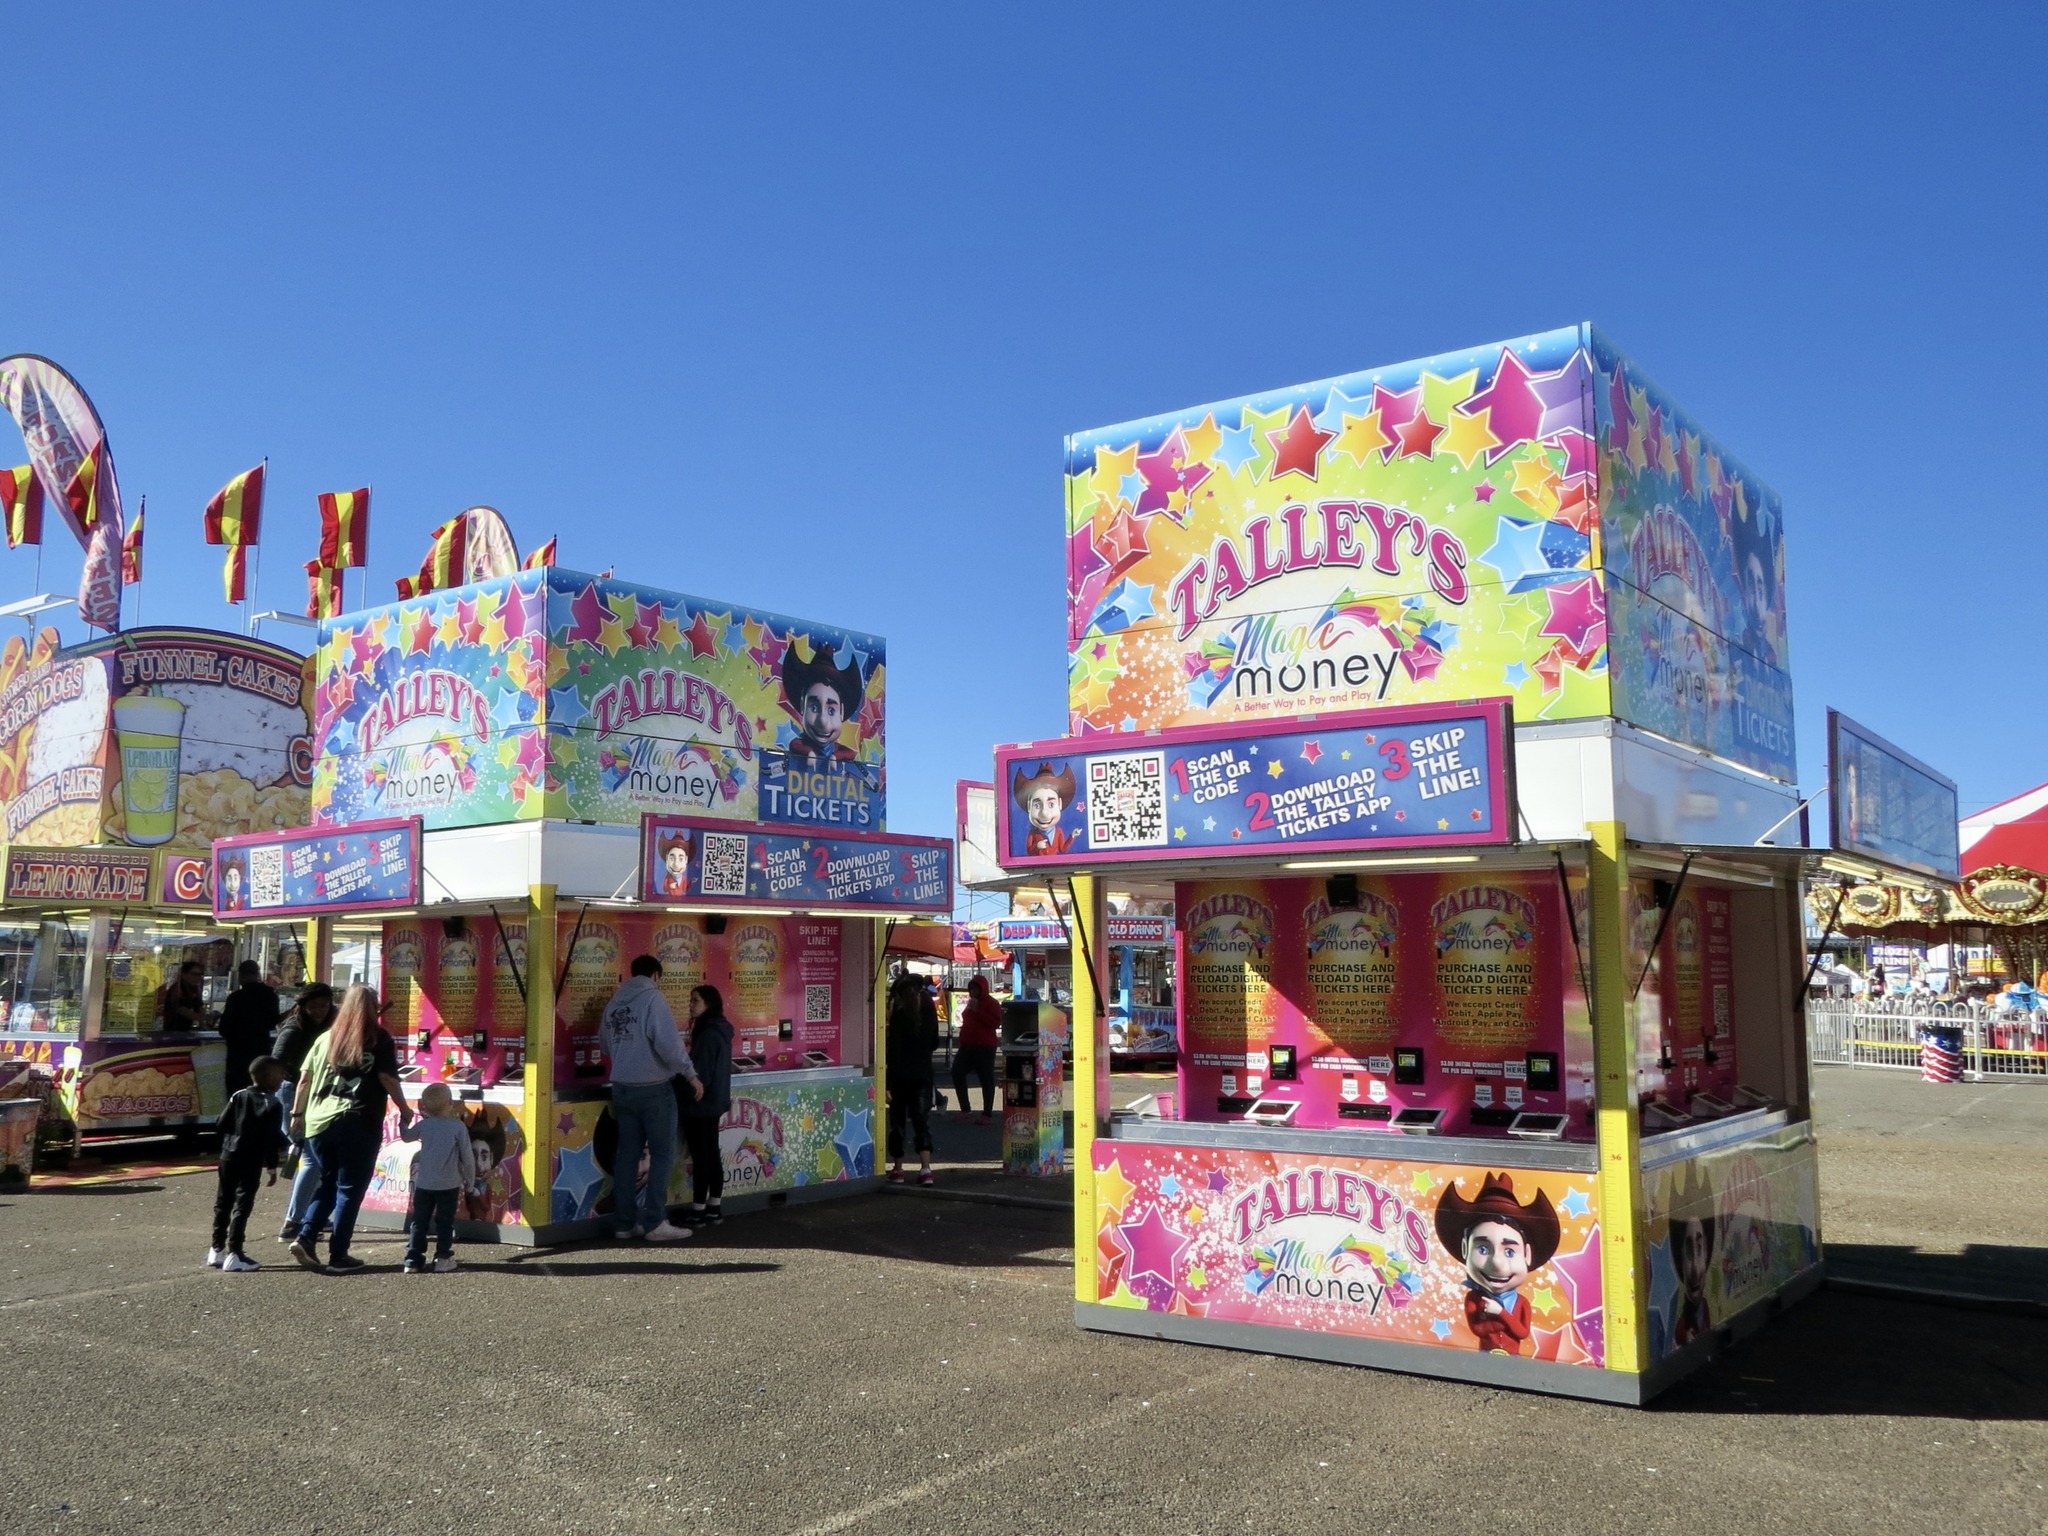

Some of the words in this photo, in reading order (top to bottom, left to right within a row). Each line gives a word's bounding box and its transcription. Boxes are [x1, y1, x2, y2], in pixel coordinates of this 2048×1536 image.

[1166, 498, 1470, 642] TALLEY'S
[1231, 615, 1354, 670] Magic
[119, 650, 222, 683] FUNNEL
[228, 656, 301, 704] CAKES
[1235, 648, 1400, 699] money
[1234, 704, 1241, 712] A
[1244, 702, 1270, 711] Better
[1274, 700, 1294, 710] Way
[1296, 698, 1306, 706] to
[1310, 695, 1326, 706] Pay
[1330, 693, 1347, 703] and
[1352, 691, 1371, 702] Play
[1660, 656, 1708, 721] money
[0, 685, 41, 745] CORN
[42, 664, 83, 710] DOGS
[359, 669, 490, 761] TALLEY'S
[593, 668, 752, 760] TALLEY'S
[1734, 693, 1790, 756] TICKETS
[1379, 739, 1411, 780] 3
[1409, 727, 1466, 759] SKIP
[1413, 751, 1463, 778] THE
[1169, 758, 1191, 794] 1
[1187, 749, 1234, 774] SCAN
[1189, 771, 1222, 789] THE
[1225, 760, 1251, 778] QR
[1418, 767, 1481, 800] LINE!
[387, 773, 458, 803] money
[630, 770, 718, 808] money
[788, 770, 869, 803] DIGITAL
[1193, 778, 1239, 804] CODE
[1245, 791, 1275, 831] 2
[1271, 768, 1376, 809] DOWNLOAD
[8, 775, 59, 838] FUNNEL
[61, 767, 102, 801] CAKES
[764, 784, 870, 824] TICKETS
[1273, 803, 1308, 823] THE
[1311, 783, 1376, 813] TALLEY
[1276, 808, 1350, 839] TICKETS
[1356, 796, 1392, 819] APP
[13, 851, 66, 862] FRESH
[70, 853, 150, 865] SQUEEZED
[285, 852, 292, 872] 1
[291, 845, 311, 860] SCAN
[292, 857, 306, 870] THE
[307, 853, 318, 864] QR
[367, 841, 380, 865] 3
[380, 833, 402, 852] SKIP
[381, 848, 400, 864] THE
[754, 842, 767, 870] 1
[767, 848, 800, 865] SCAN
[293, 866, 313, 879] CODE
[382, 858, 407, 878] LINE!
[763, 866, 785, 880] THE
[790, 860, 806, 873] QR
[812, 846, 829, 880] 2
[827, 849, 890, 874] DOWNLOAD
[829, 872, 850, 887] THE
[853, 861, 891, 880] TALLEY
[899, 852, 916, 883] 3
[911, 849, 939, 869] SKIP
[914, 866, 939, 884] THE
[9, 864, 148, 900] LEMONADE
[314, 871, 326, 896] 2
[324, 858, 367, 882] DOWNLOAD
[325, 879, 339, 891] THE
[341, 868, 367, 887] TALLEY
[326, 882, 357, 900] TICKETS
[357, 875, 373, 888] APP
[770, 874, 802, 892] CODE
[826, 880, 872, 900] TICKETS
[875, 873, 896, 889] APP
[912, 880, 944, 901] LINE!
[1186, 893, 1274, 931] TALLEY'S
[1431, 885, 1536, 928] TALLEY'S
[799, 926, 820, 935] SKIP
[822, 926, 839, 935] THE
[807, 936, 830, 945] LINE!
[1003, 925, 1032, 939] DEEP
[1034, 924, 1066, 939] FRIE
[1108, 925, 1126, 935] OLD
[1128, 925, 1163, 936] DRINKS
[1207, 941, 1255, 956] money
[1326, 940, 1377, 955] money
[1456, 938, 1512, 954] money
[1190, 975, 1229, 983] RELOAD
[1233, 975, 1272, 983] DIGITAL
[1191, 965, 1244, 973] PURCHASE
[1248, 965, 1270, 973] AND
[1308, 974, 1350, 983] RELOAD
[1354, 974, 1398, 983] DIGITAL
[1309, 964, 1367, 972] PURCHASE
[1371, 964, 1395, 972] AND
[1437, 975, 1483, 984] RELOAD
[1487, 975, 1535, 984] DIGITAL
[1438, 964, 1501, 973] PURCHASE
[1506, 964, 1532, 973] AND
[1196, 984, 1237, 993] TICKETS
[1241, 984, 1267, 993] HERE
[1314, 985, 1359, 993] TICKETS
[1363, 985, 1391, 993] HERE
[1443, 985, 1492, 995] TICKETS
[1497, 986, 1528, 995] HERE
[101, 1096, 191, 1114] NACHOS
[1042, 1118, 1061, 1128] HERE
[1011, 1149, 1034, 1158] HERE
[1610, 1153, 1622, 1161] 36
[1233, 1167, 1429, 1264] TALLEY'S
[1614, 1235, 1625, 1243] 24
[1274, 1238, 1355, 1280] Magic
[1276, 1273, 1383, 1316] money
[1617, 1317, 1628, 1325] 12
